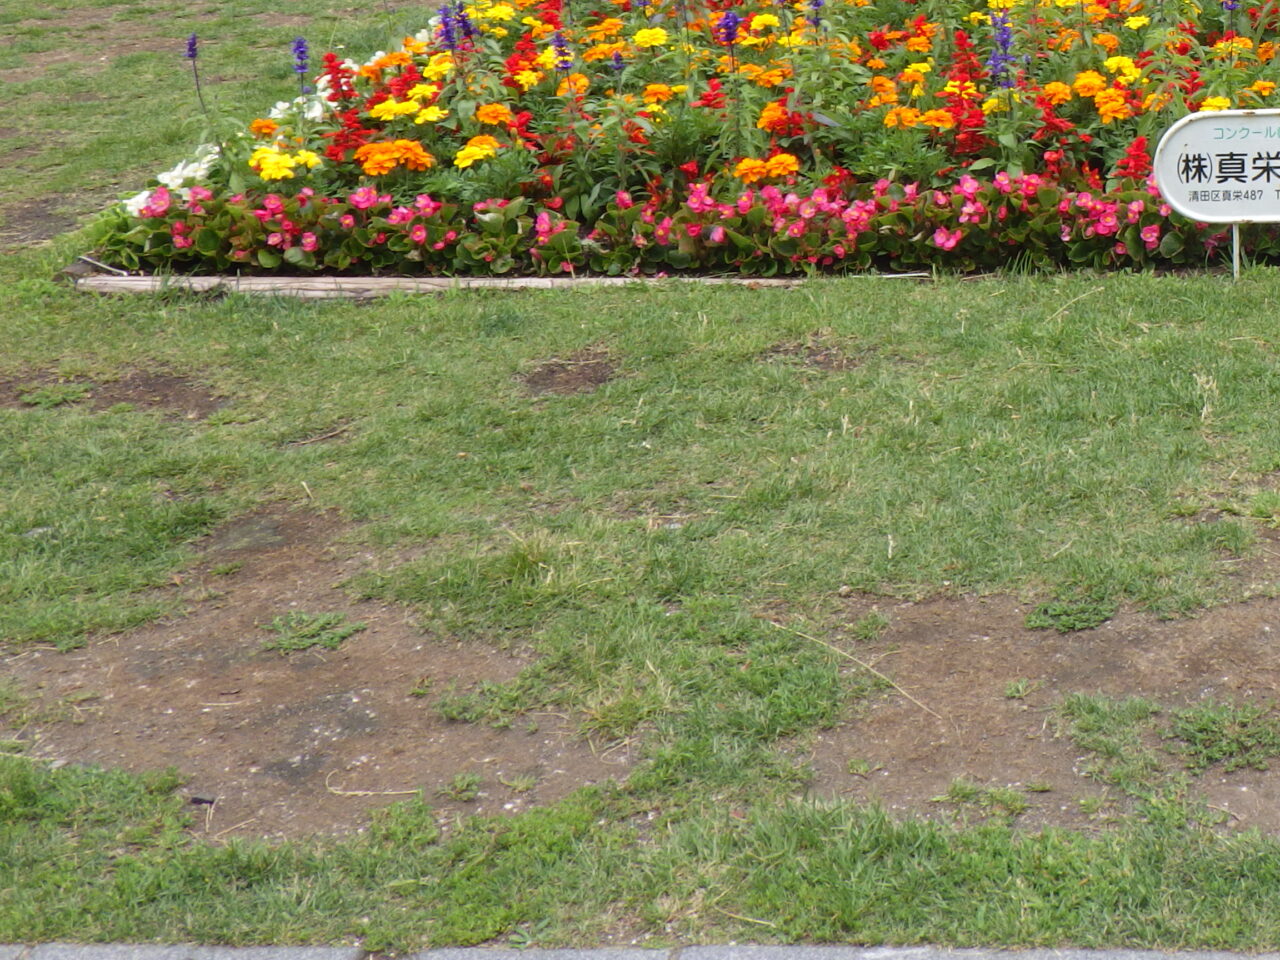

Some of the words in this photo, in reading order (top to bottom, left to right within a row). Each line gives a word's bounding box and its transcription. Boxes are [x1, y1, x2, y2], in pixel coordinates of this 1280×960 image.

[1188, 189, 1264, 202] 清田区真栄487
